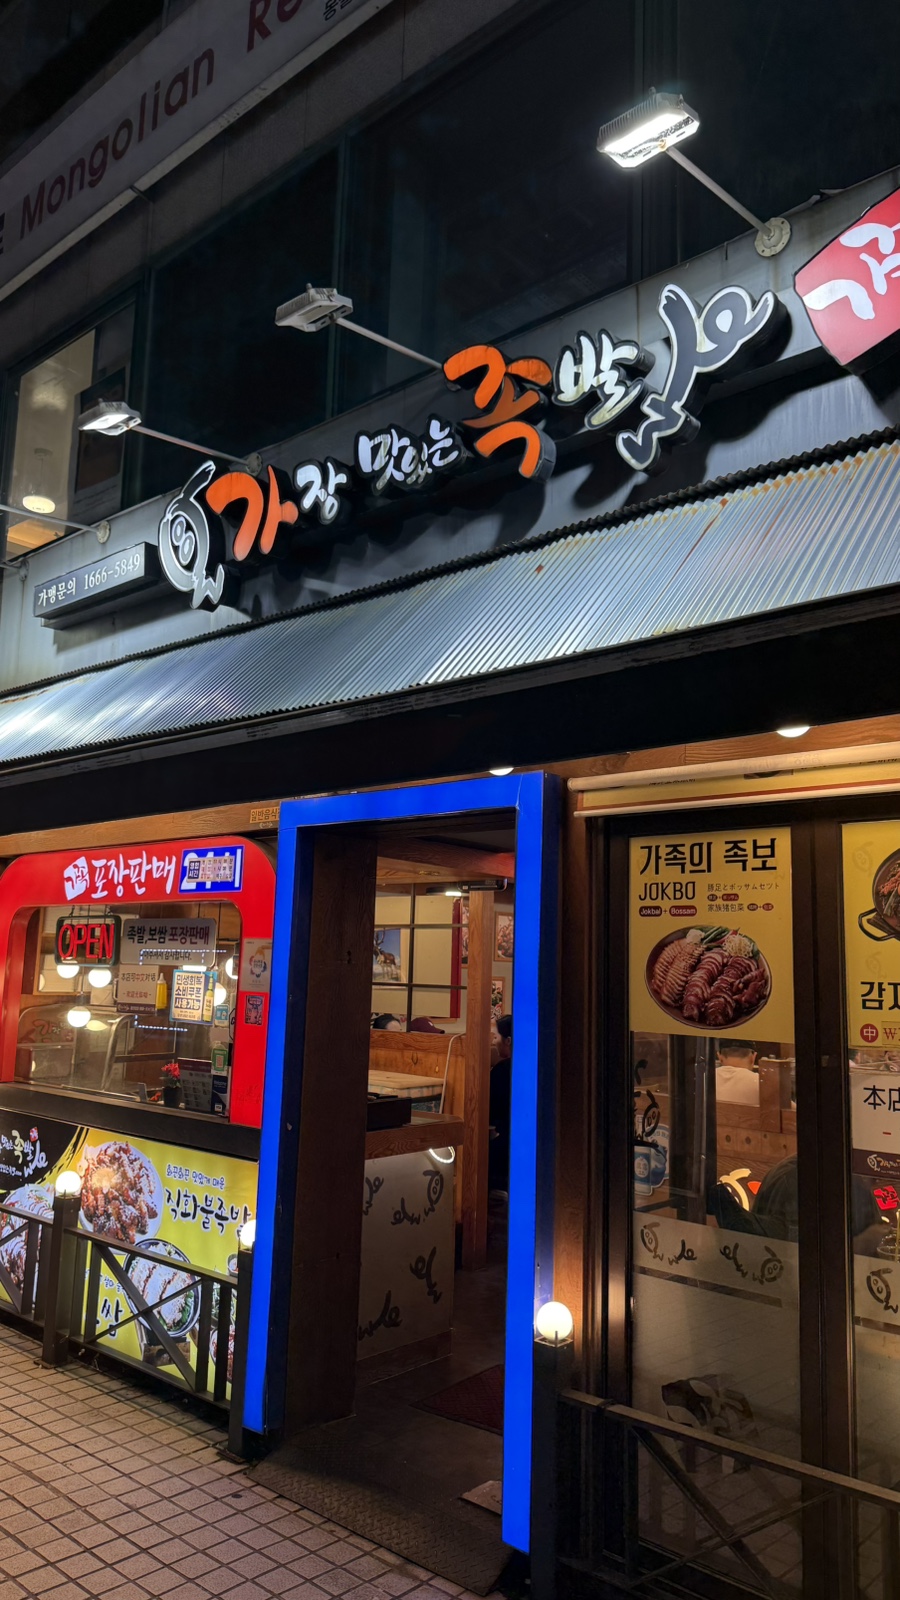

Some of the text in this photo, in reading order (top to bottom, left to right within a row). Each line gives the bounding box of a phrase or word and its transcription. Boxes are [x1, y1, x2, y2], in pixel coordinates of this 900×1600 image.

[20, 48, 215, 239] Mongolian
[205, 333, 643, 562] 가장 맛있는 족발
[38, 554, 140, 607] 가맹문의 1666-5849
[252, 807, 280, 822] 일반음식
[640, 838, 777, 875] 가족의 족보
[91, 851, 176, 899] 포장판매
[639, 881, 696, 901] JOKBO
[640, 907, 696, 916] Jokbal Bossam
[58, 923, 115, 959] OPEN
[127, 926, 210, 945] 족발,보쌈 포장판매
[177, 974, 203, 986] 민생회복
[175, 986, 202, 998] 소비쿠폰
[175, 997, 201, 1010] 사용가능
[863, 1026, 876, 1041] 中
[192, 1171, 211, 1185] 맛있게
[213, 1177, 225, 1189] 매운
[97, 1299, 123, 1337] 쌈
